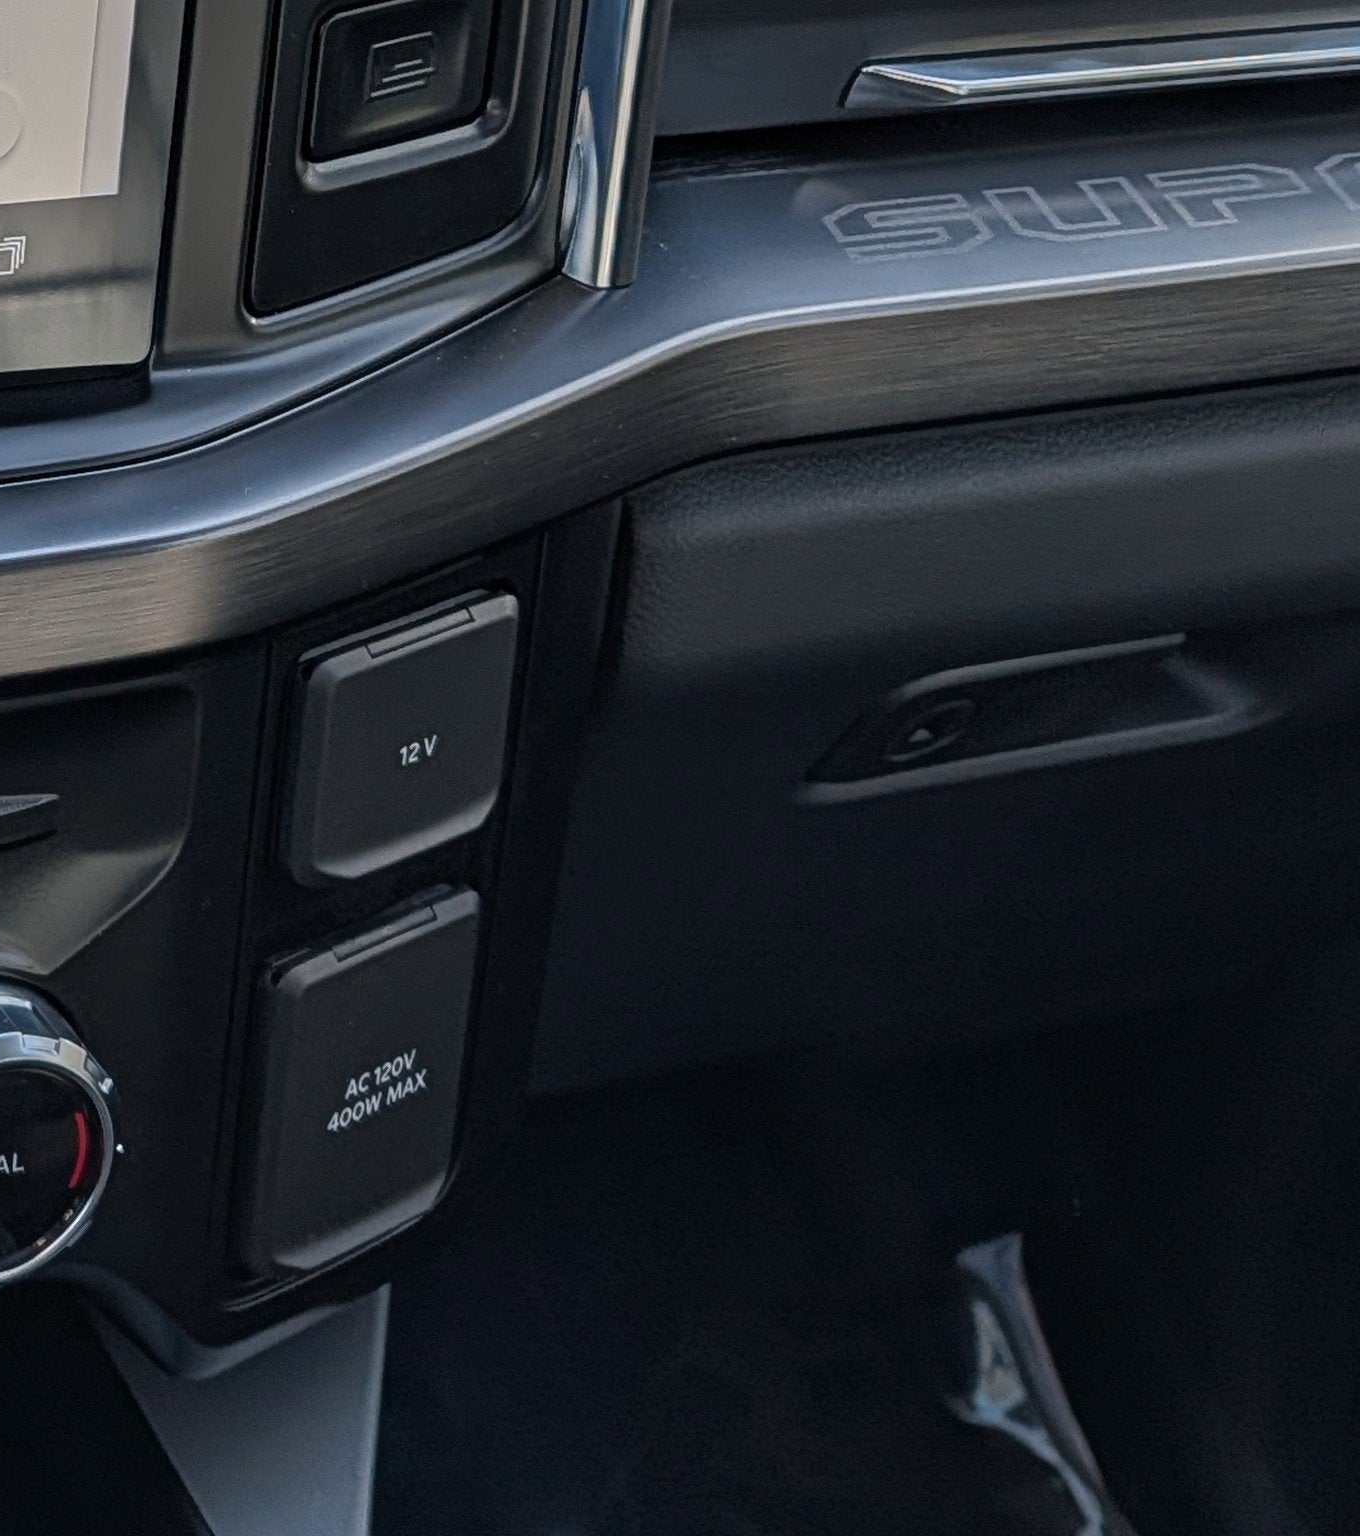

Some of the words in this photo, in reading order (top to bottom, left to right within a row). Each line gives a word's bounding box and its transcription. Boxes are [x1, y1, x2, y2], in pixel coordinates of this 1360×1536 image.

[821, 151, 1360, 262] SUP
[325, 1088, 382, 1134] 400W
[382, 1067, 430, 1106] MAX
[343, 1068, 373, 1101] AC
[372, 1047, 418, 1086] 120V
